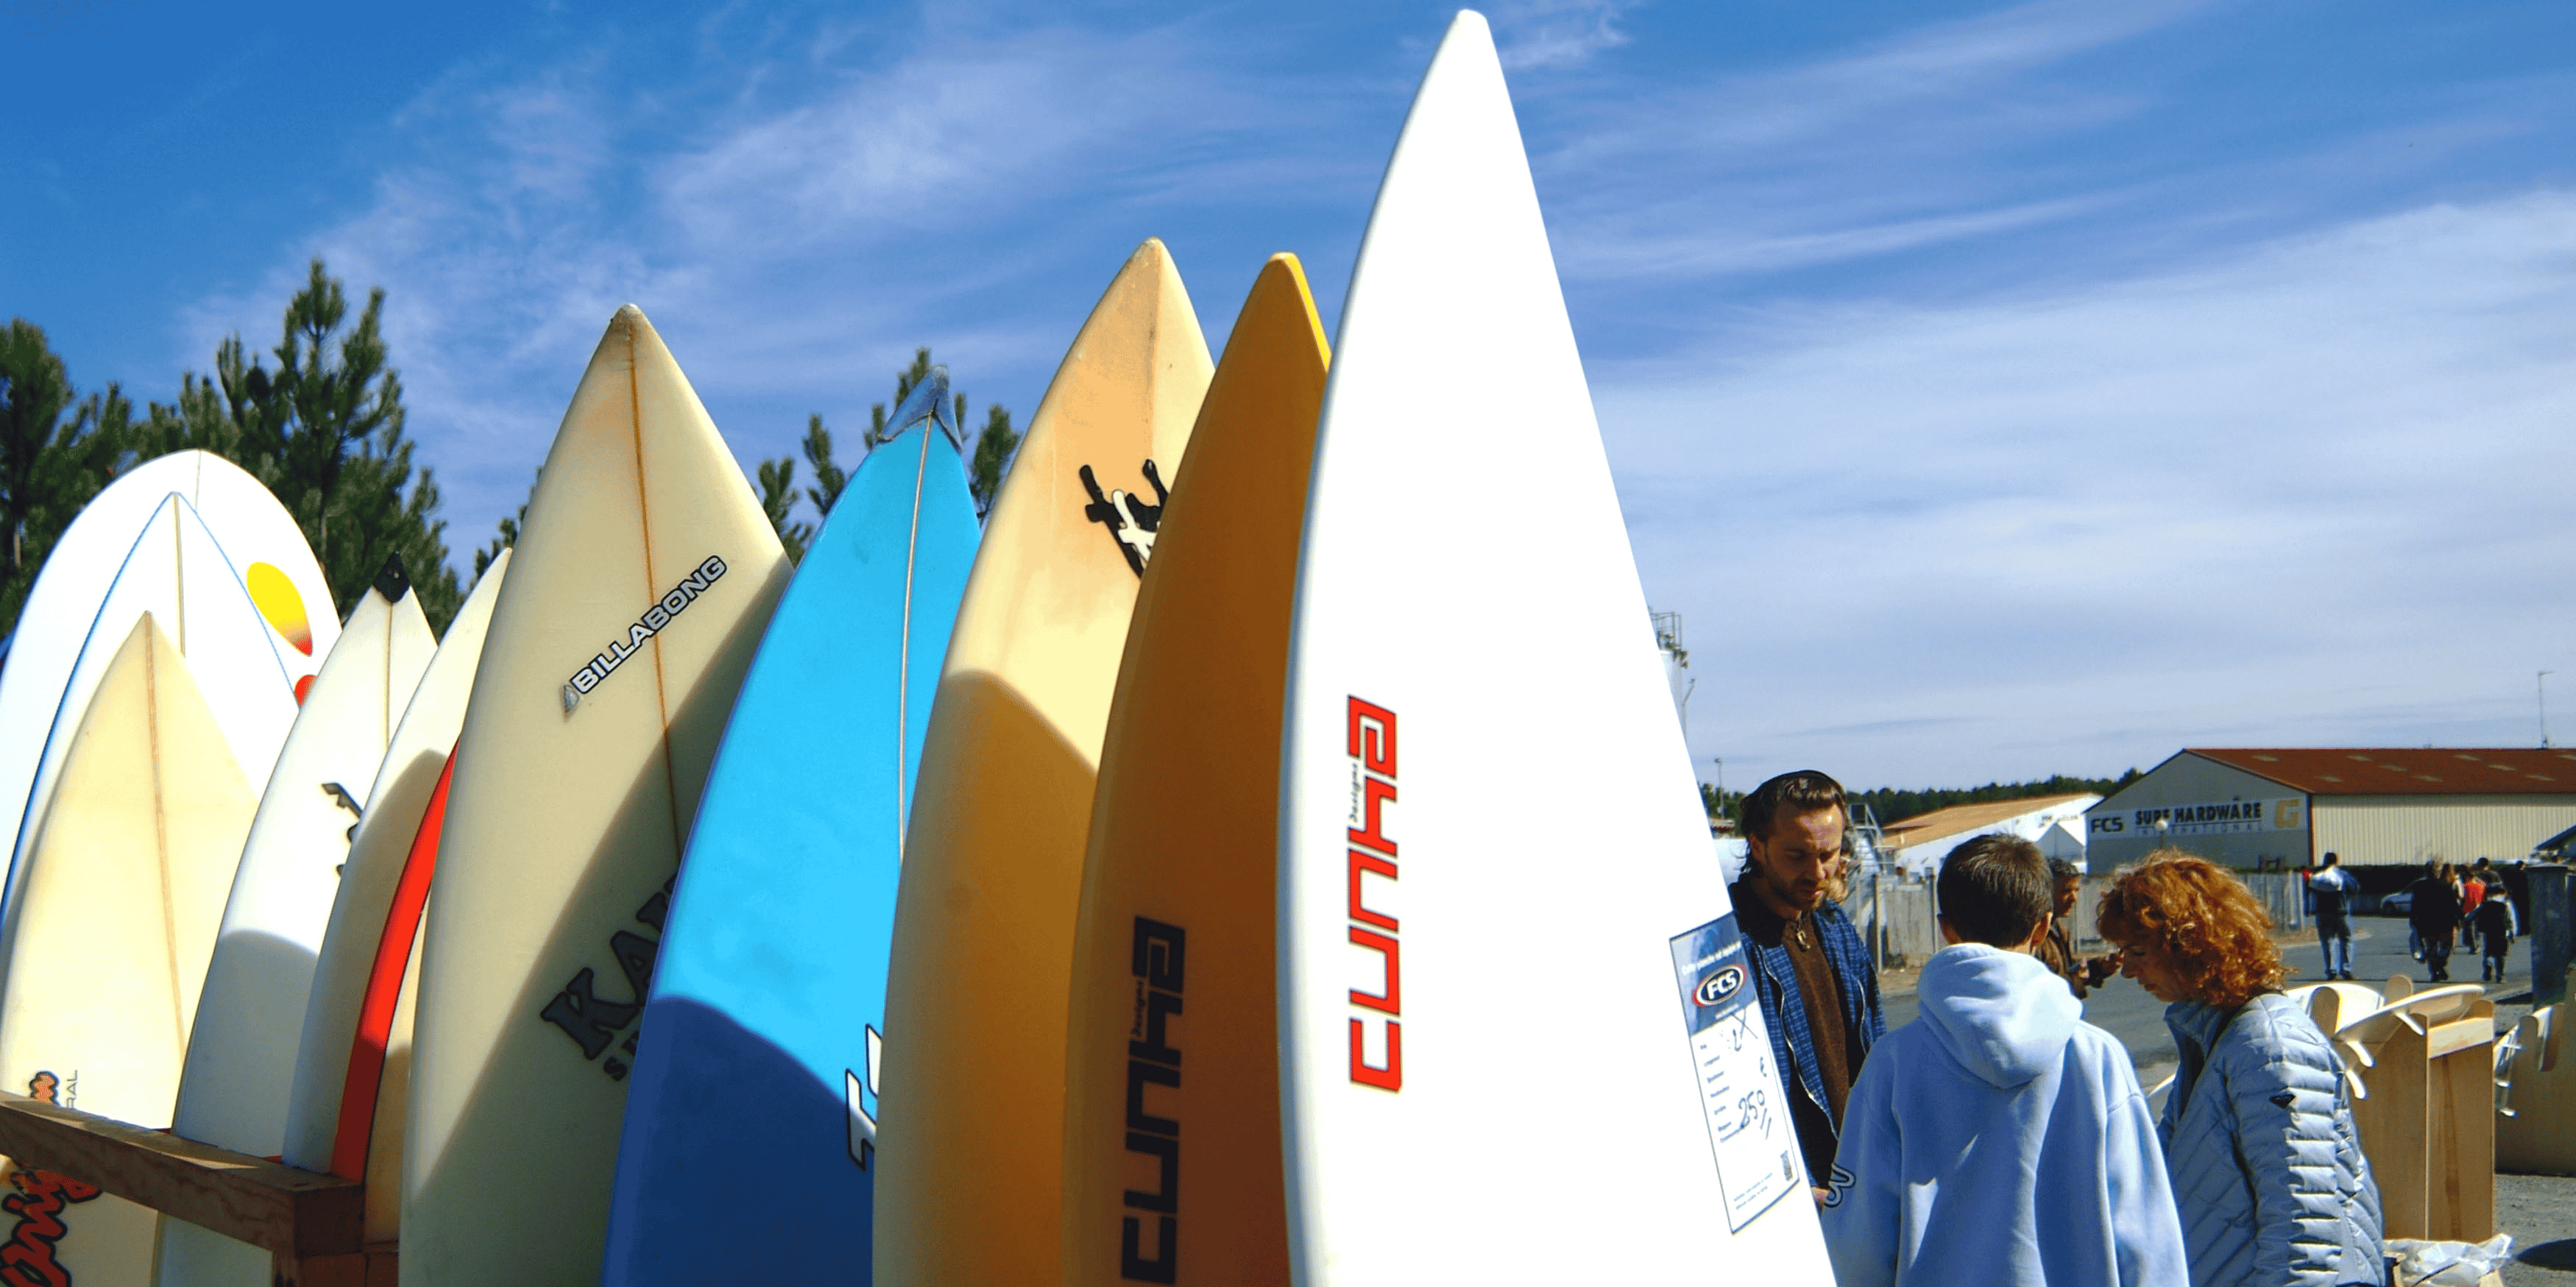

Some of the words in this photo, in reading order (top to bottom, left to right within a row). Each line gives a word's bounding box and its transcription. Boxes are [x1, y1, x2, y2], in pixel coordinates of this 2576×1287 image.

[570, 555, 728, 695] BILLABONG
[2090, 816, 2124, 833] FCS
[2174, 802, 2262, 823] HARDWARE
[1707, 970, 1737, 999] FCS
